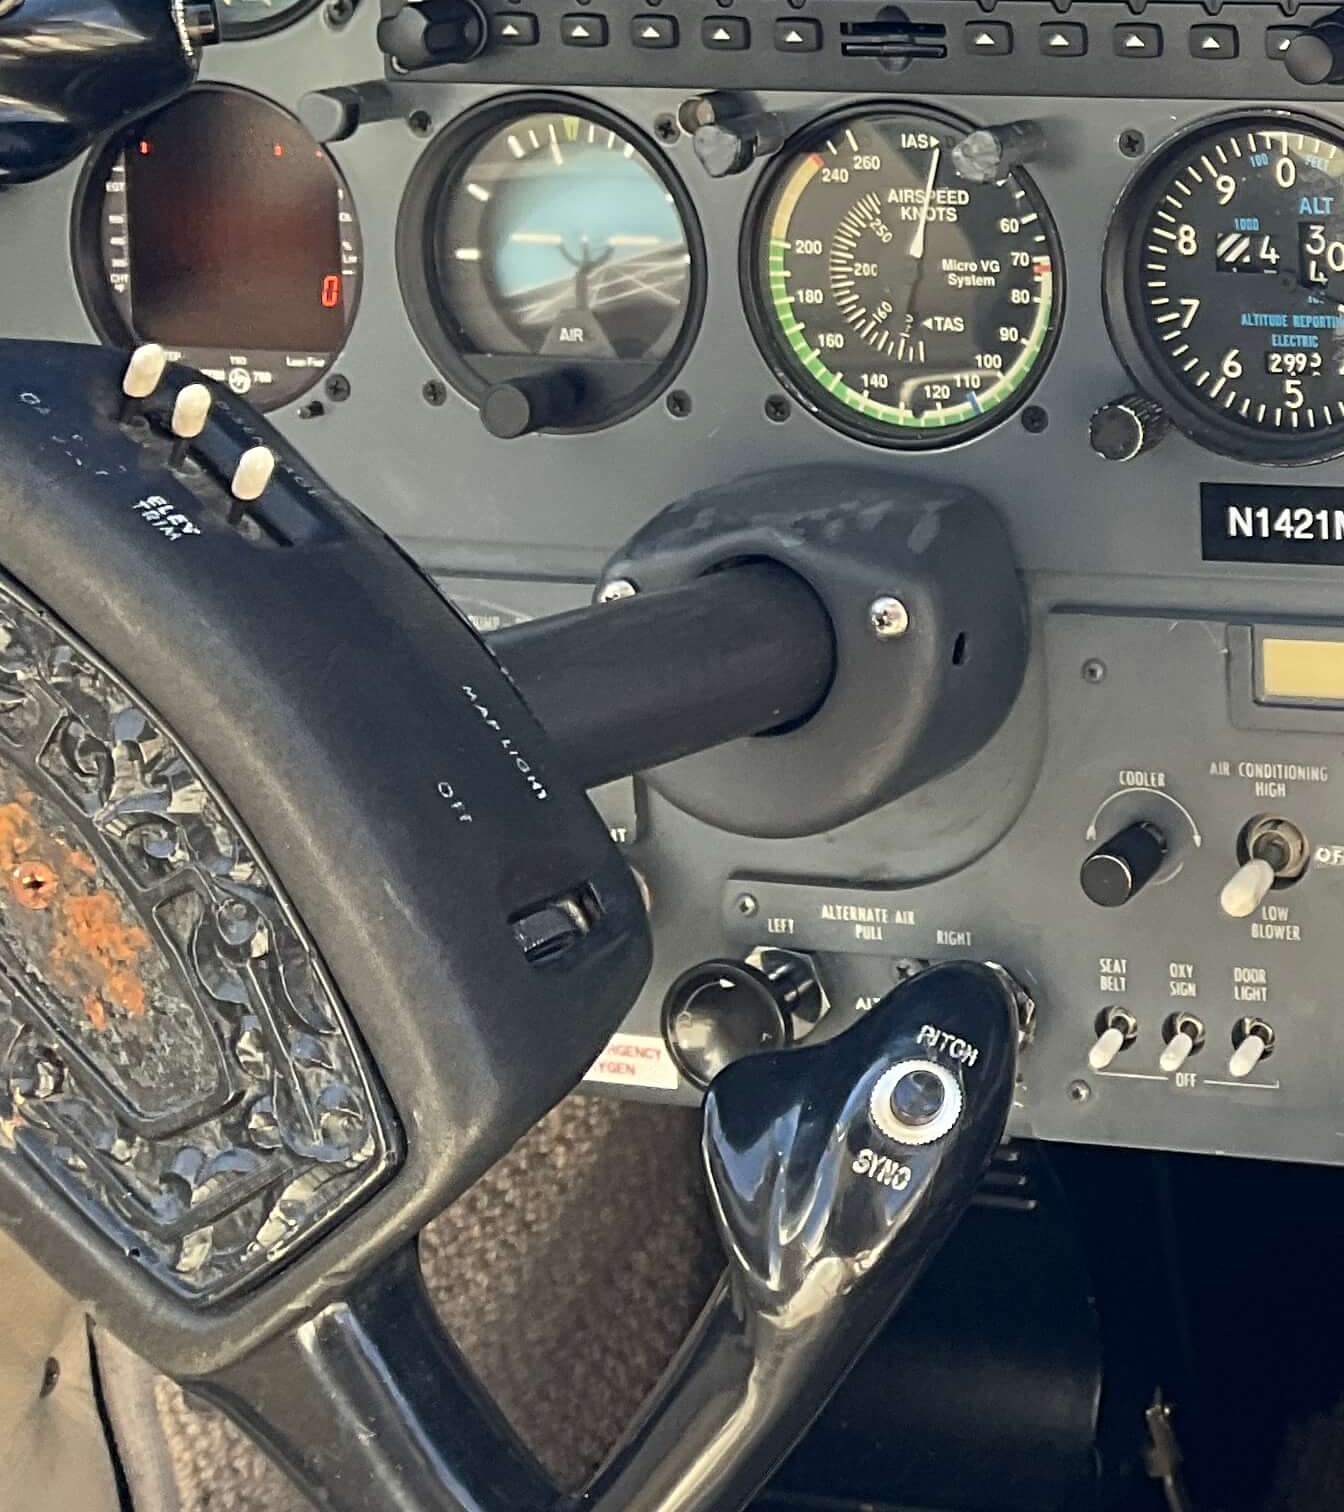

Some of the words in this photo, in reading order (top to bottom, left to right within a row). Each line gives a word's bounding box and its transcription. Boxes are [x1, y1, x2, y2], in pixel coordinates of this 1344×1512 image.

[948, 273, 995, 288] System
[1234, 968, 1266, 984] DOOR
[1234, 986, 1268, 1002] LIGHT
